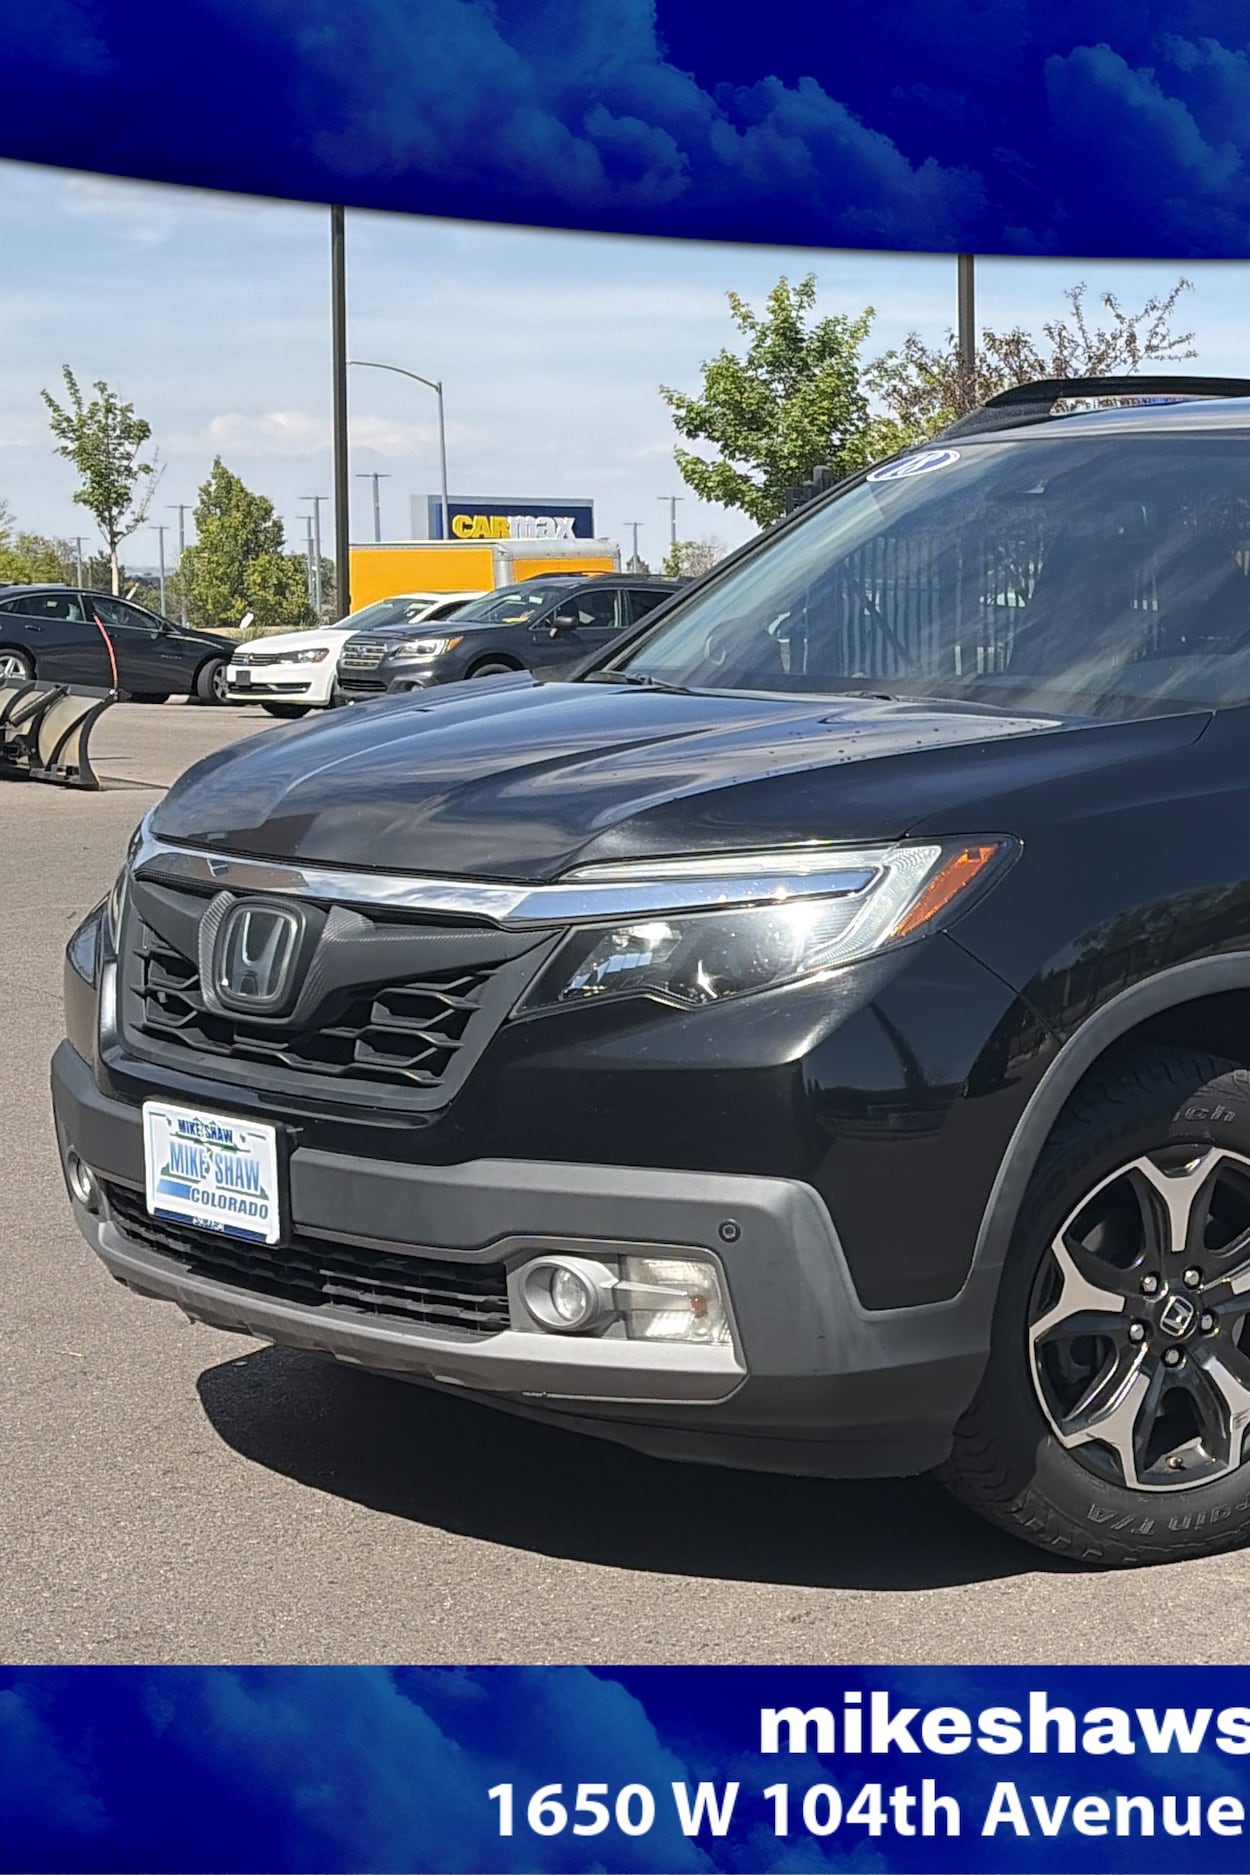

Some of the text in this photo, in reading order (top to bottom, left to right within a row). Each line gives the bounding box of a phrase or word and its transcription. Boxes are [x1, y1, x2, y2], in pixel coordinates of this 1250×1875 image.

[177, 1118, 234, 1144] MIKE SHAW
[169, 1141, 261, 1192] MIKE SHAW
[190, 1187, 269, 1220] COLORADO
